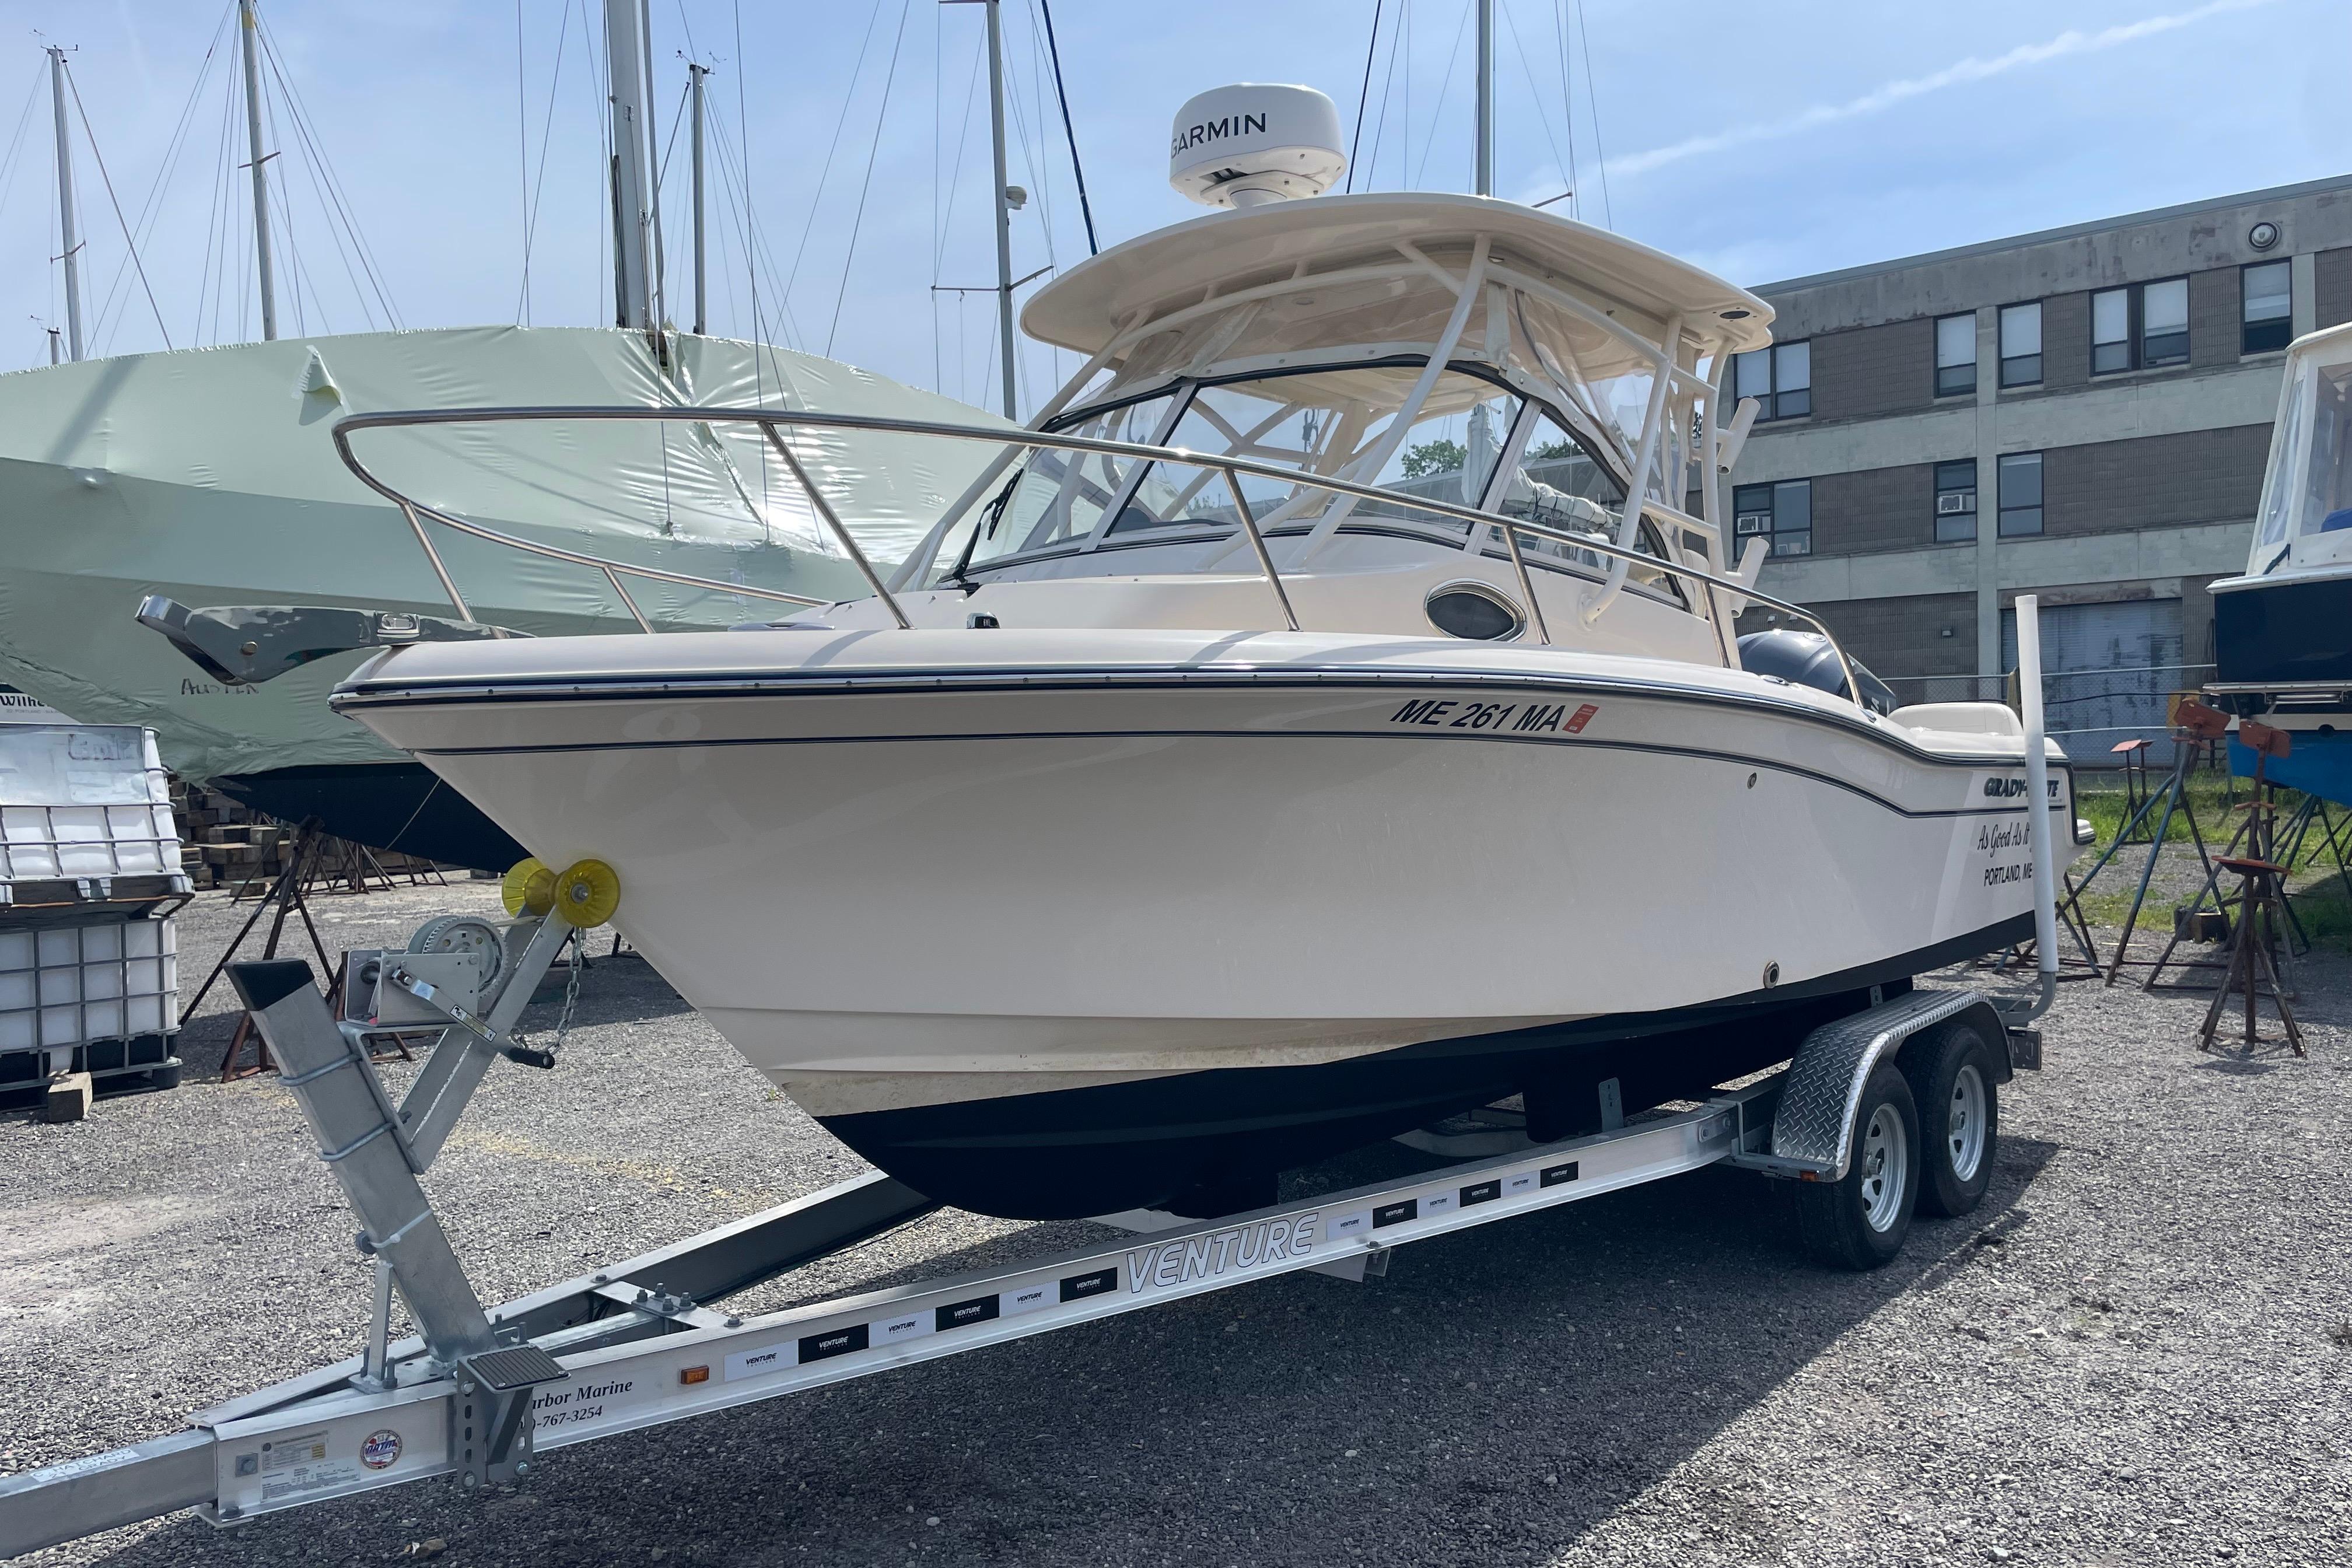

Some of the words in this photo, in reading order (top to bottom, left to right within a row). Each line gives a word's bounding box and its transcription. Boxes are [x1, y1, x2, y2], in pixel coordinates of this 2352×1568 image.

[1171, 113, 1266, 160] GARMIN
[1390, 699, 1459, 725] ME
[1449, 703, 1517, 729] 261
[1512, 705, 1566, 732] MA
[1977, 825, 1989, 850] As
[1990, 822, 2013, 858] Good
[2012, 822, 2021, 846] As
[1984, 864, 2021, 887] PORTLAND,
[2022, 862, 2032, 880] ME
[1126, 1212, 1319, 1294] VENTURE
[1076, 1278, 1101, 1289] VENTURE
[1017, 1292, 1043, 1302] VENTURE
[954, 1306, 981, 1317] VENTURE
[888, 1320, 916, 1332] VENTURE
[819, 1336, 849, 1348] VENTURE
[746, 1352, 777, 1366] VENTURE
[576, 1381, 633, 1401] Marine
[533, 1405, 603, 1429] )-767-3254
